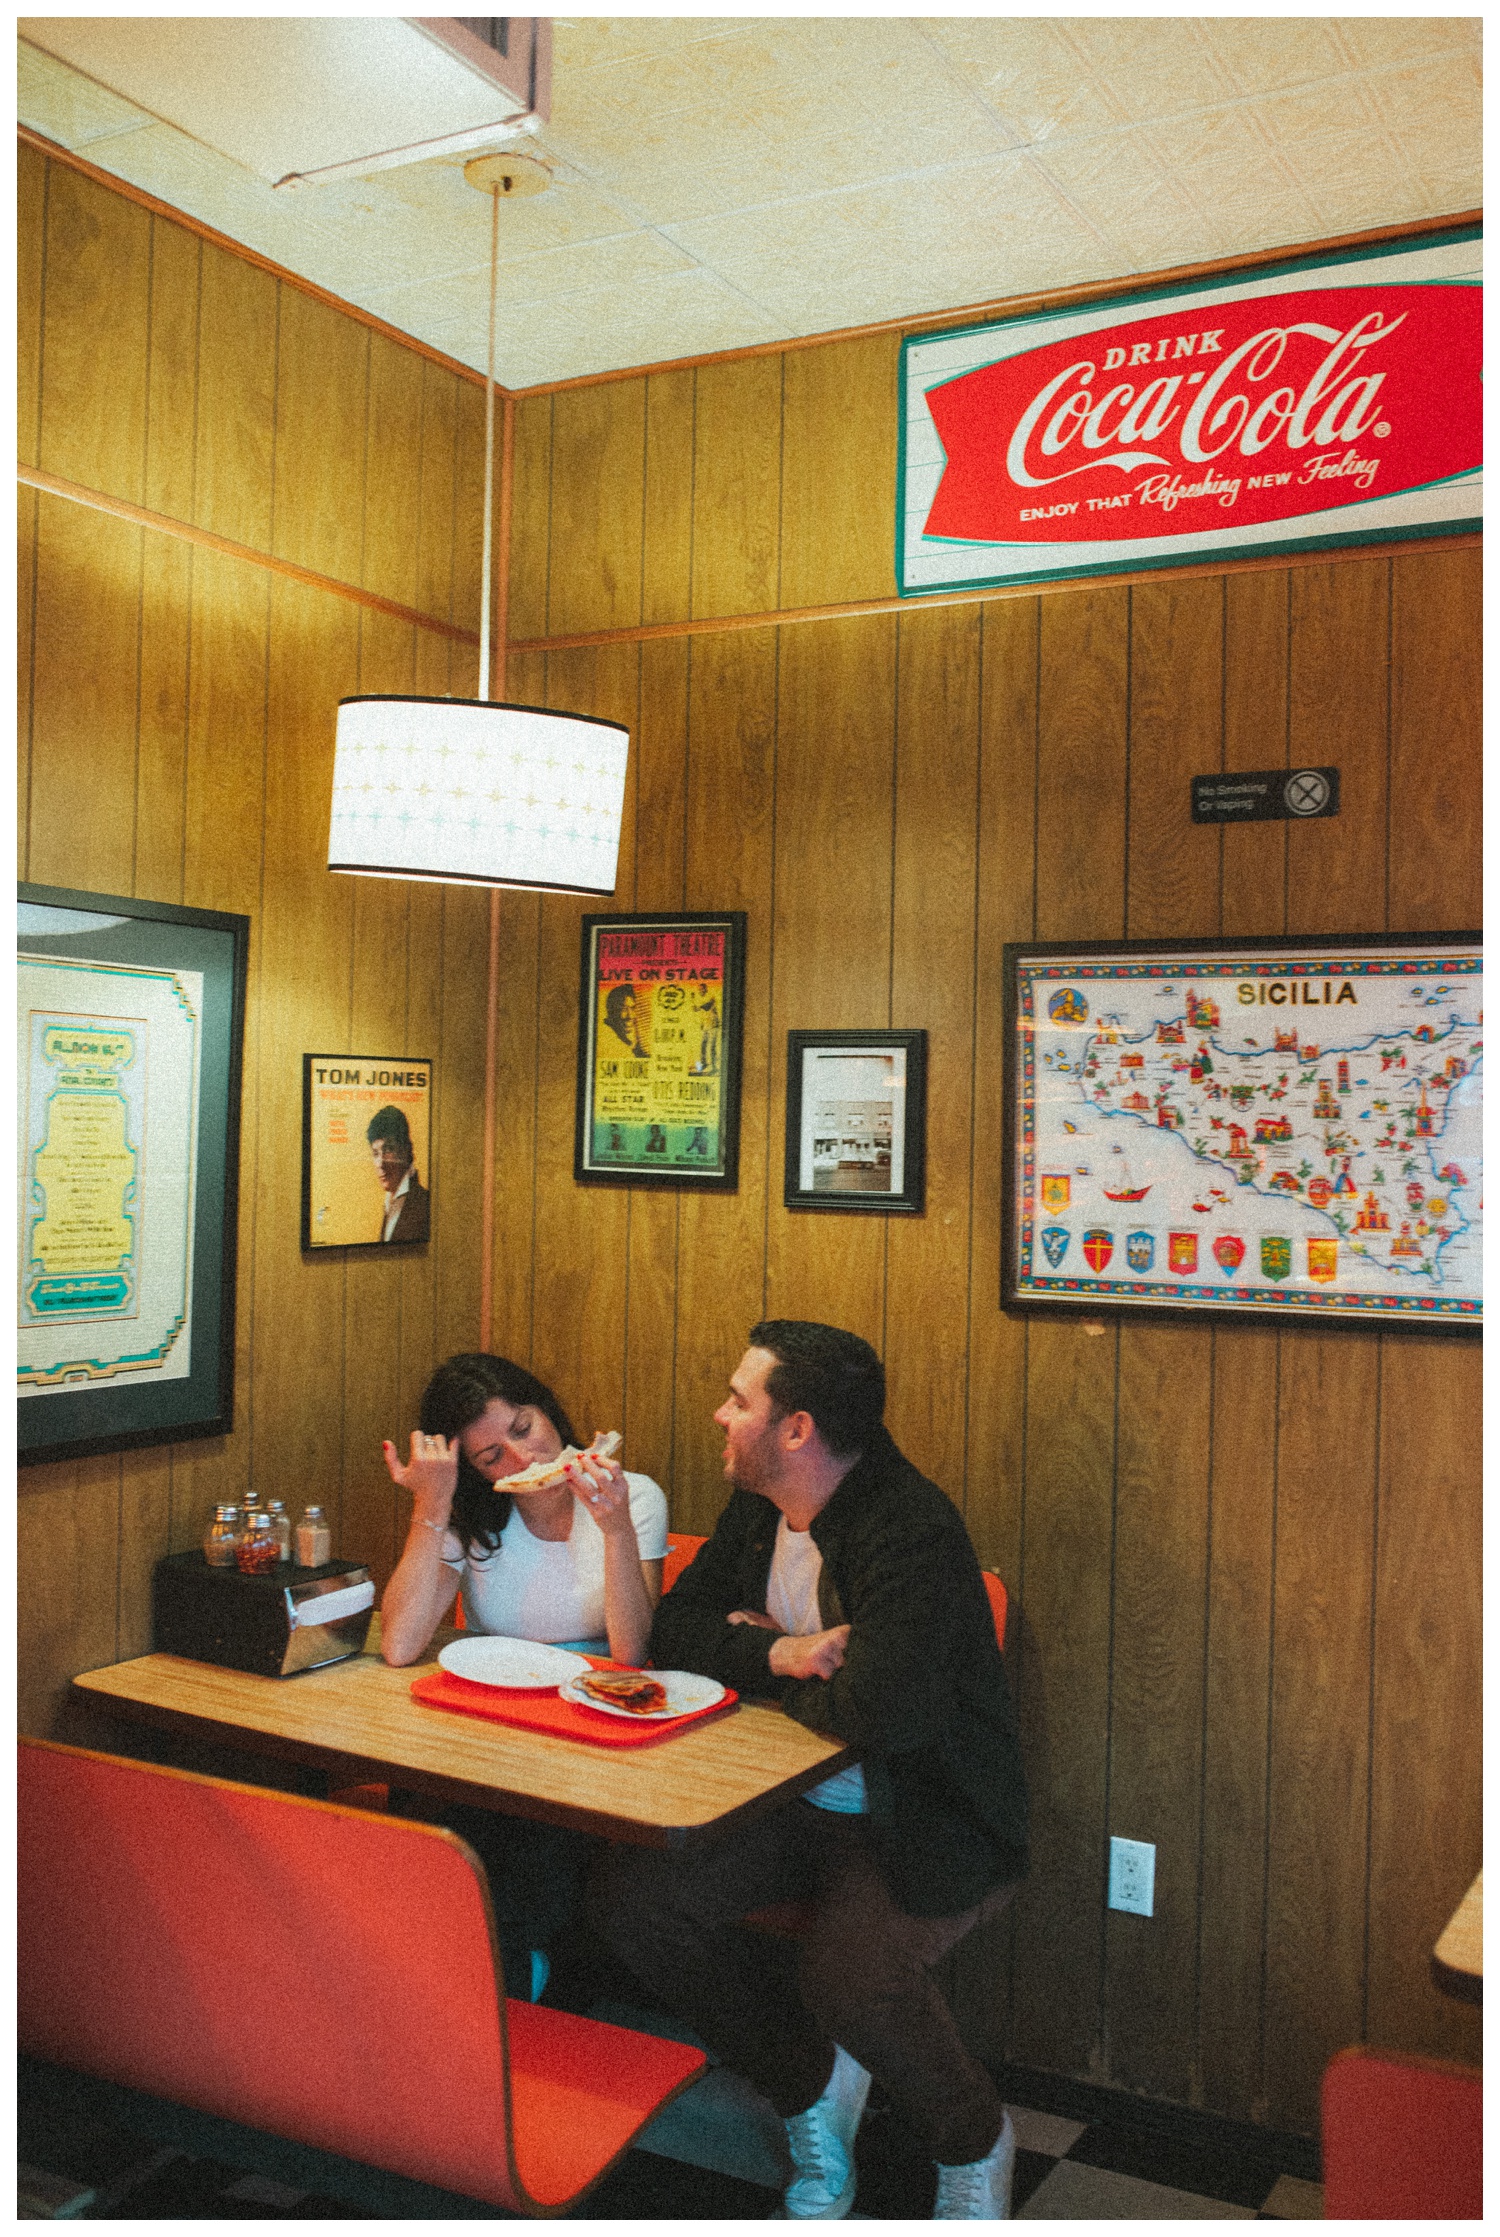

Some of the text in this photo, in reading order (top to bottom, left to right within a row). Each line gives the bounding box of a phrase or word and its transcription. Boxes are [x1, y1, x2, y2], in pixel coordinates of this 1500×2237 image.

[1103, 328, 1225, 371] DRINK
[1019, 450, 1381, 522] ENJOY THAT Refreshing NEW Feeling
[1198, 784, 1268, 797] No Smoking
[1198, 800, 1254, 812] Or Vaping
[600, 934, 721, 958] PARAMOUNT THEATRE
[599, 968, 720, 982] LIVE ON STAGE
[1237, 981, 1359, 1006] SICILIA
[316, 1068, 427, 1087] TOM JONES
[603, 1095, 644, 1103] ALL STAR
